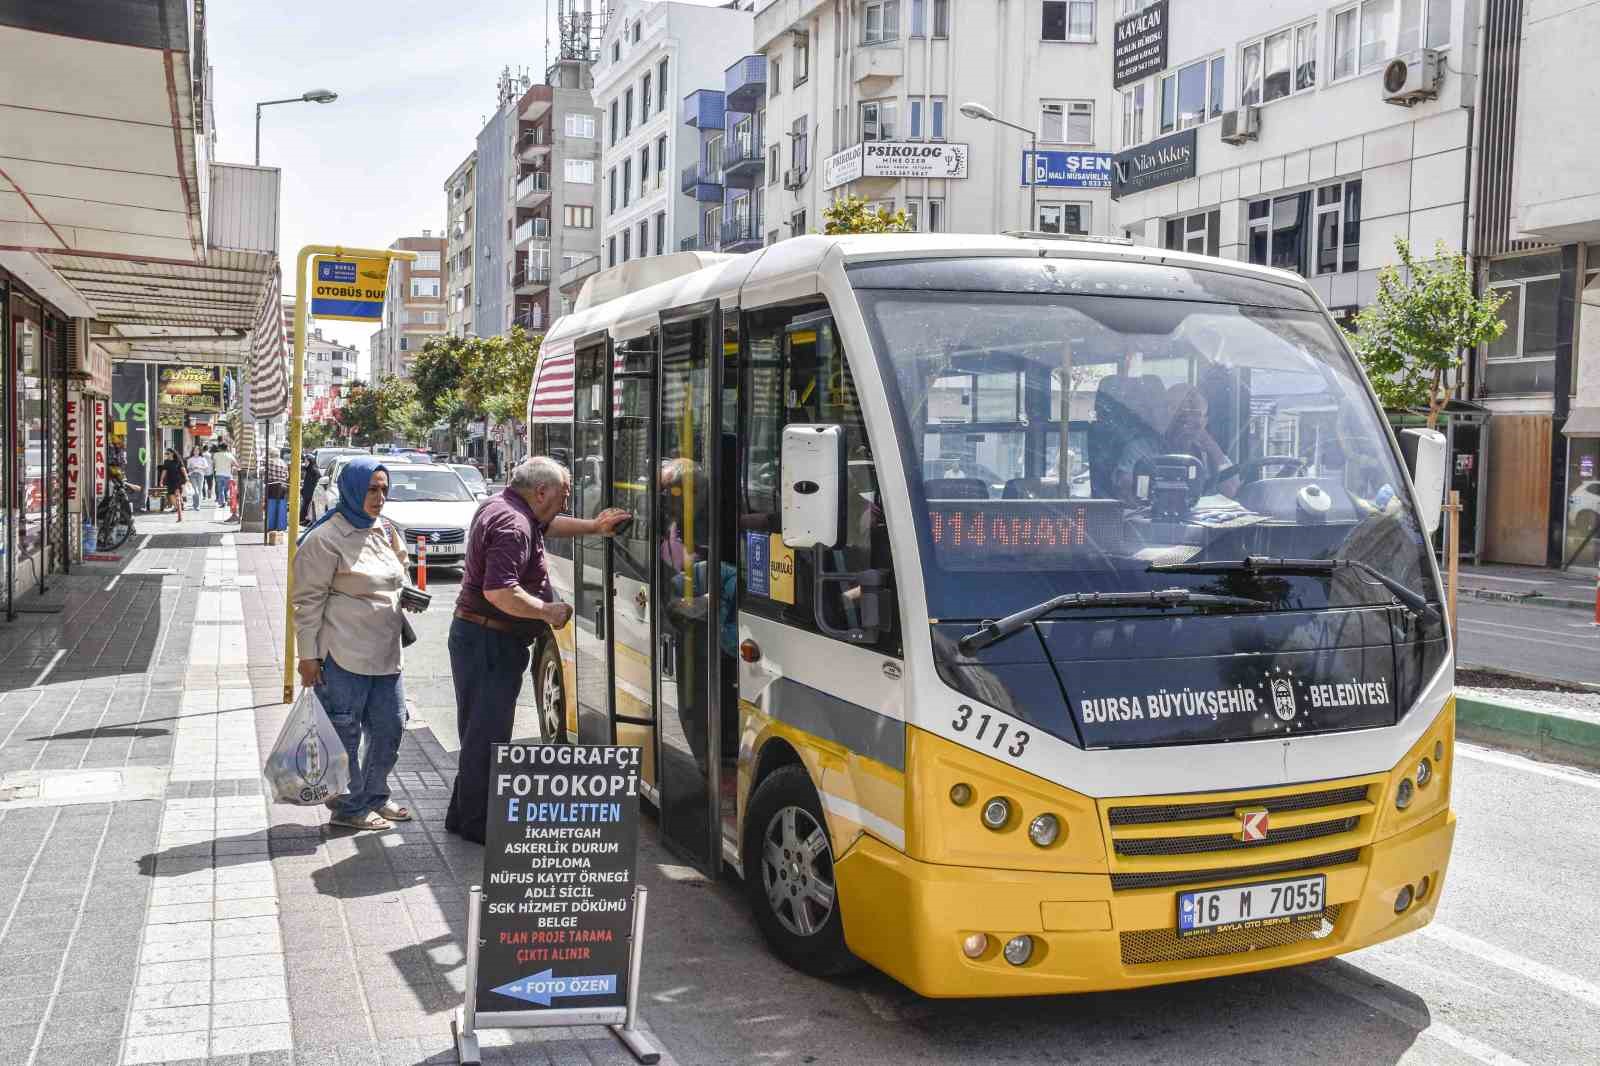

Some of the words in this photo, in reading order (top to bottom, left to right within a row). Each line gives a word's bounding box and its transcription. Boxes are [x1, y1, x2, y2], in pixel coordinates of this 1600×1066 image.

[1118, 9, 1161, 41] KAYACAN
[867, 144, 942, 157] PSİKOLOG
[1066, 155, 1112, 172] ŞEN
[317, 286, 362, 297] OTOBÜS
[67, 401, 78, 499] ECZANE
[96, 403, 105, 495] ECZANE
[1081, 696, 1145, 724] BURSA
[1147, 684, 1259, 721] BÜYÜKŞEHİR
[1309, 676, 1390, 707] BELEDİYESİ
[951, 704, 1031, 758] 3113
[497, 745, 640, 769] FOTOGRAFÇI
[496, 769, 638, 797] FOTOKOPİ
[507, 798, 520, 822] E
[526, 802, 621, 822] DEVLETTEN
[525, 825, 601, 839] İKAMETGAH
[504, 840, 569, 854] ASKERLİK
[572, 842, 619, 854] DURUM
[531, 855, 591, 868] DİPLOMA
[490, 870, 535, 884] NÜFUS
[537, 872, 577, 883] KAYIT
[524, 885, 556, 898] ADLİ
[559, 884, 594, 898] SİCİL
[488, 902, 515, 914] SGK
[518, 900, 568, 913] HİZMET
[571, 898, 627, 912] DÖKÜMÜ
[1196, 894, 1221, 924] 16
[1239, 890, 1252, 918] M
[1270, 882, 1321, 914] 7055
[538, 916, 579, 928] BELGE
[500, 931, 528, 944] PLAN
[532, 930, 565, 943] PROJE
[568, 929, 614, 943] TARAMA
[516, 948, 548, 964] ÇIKTI
[551, 947, 591, 961] ALINIR
[526, 981, 566, 994] FOTO
[570, 976, 609, 993] ÖZEN
